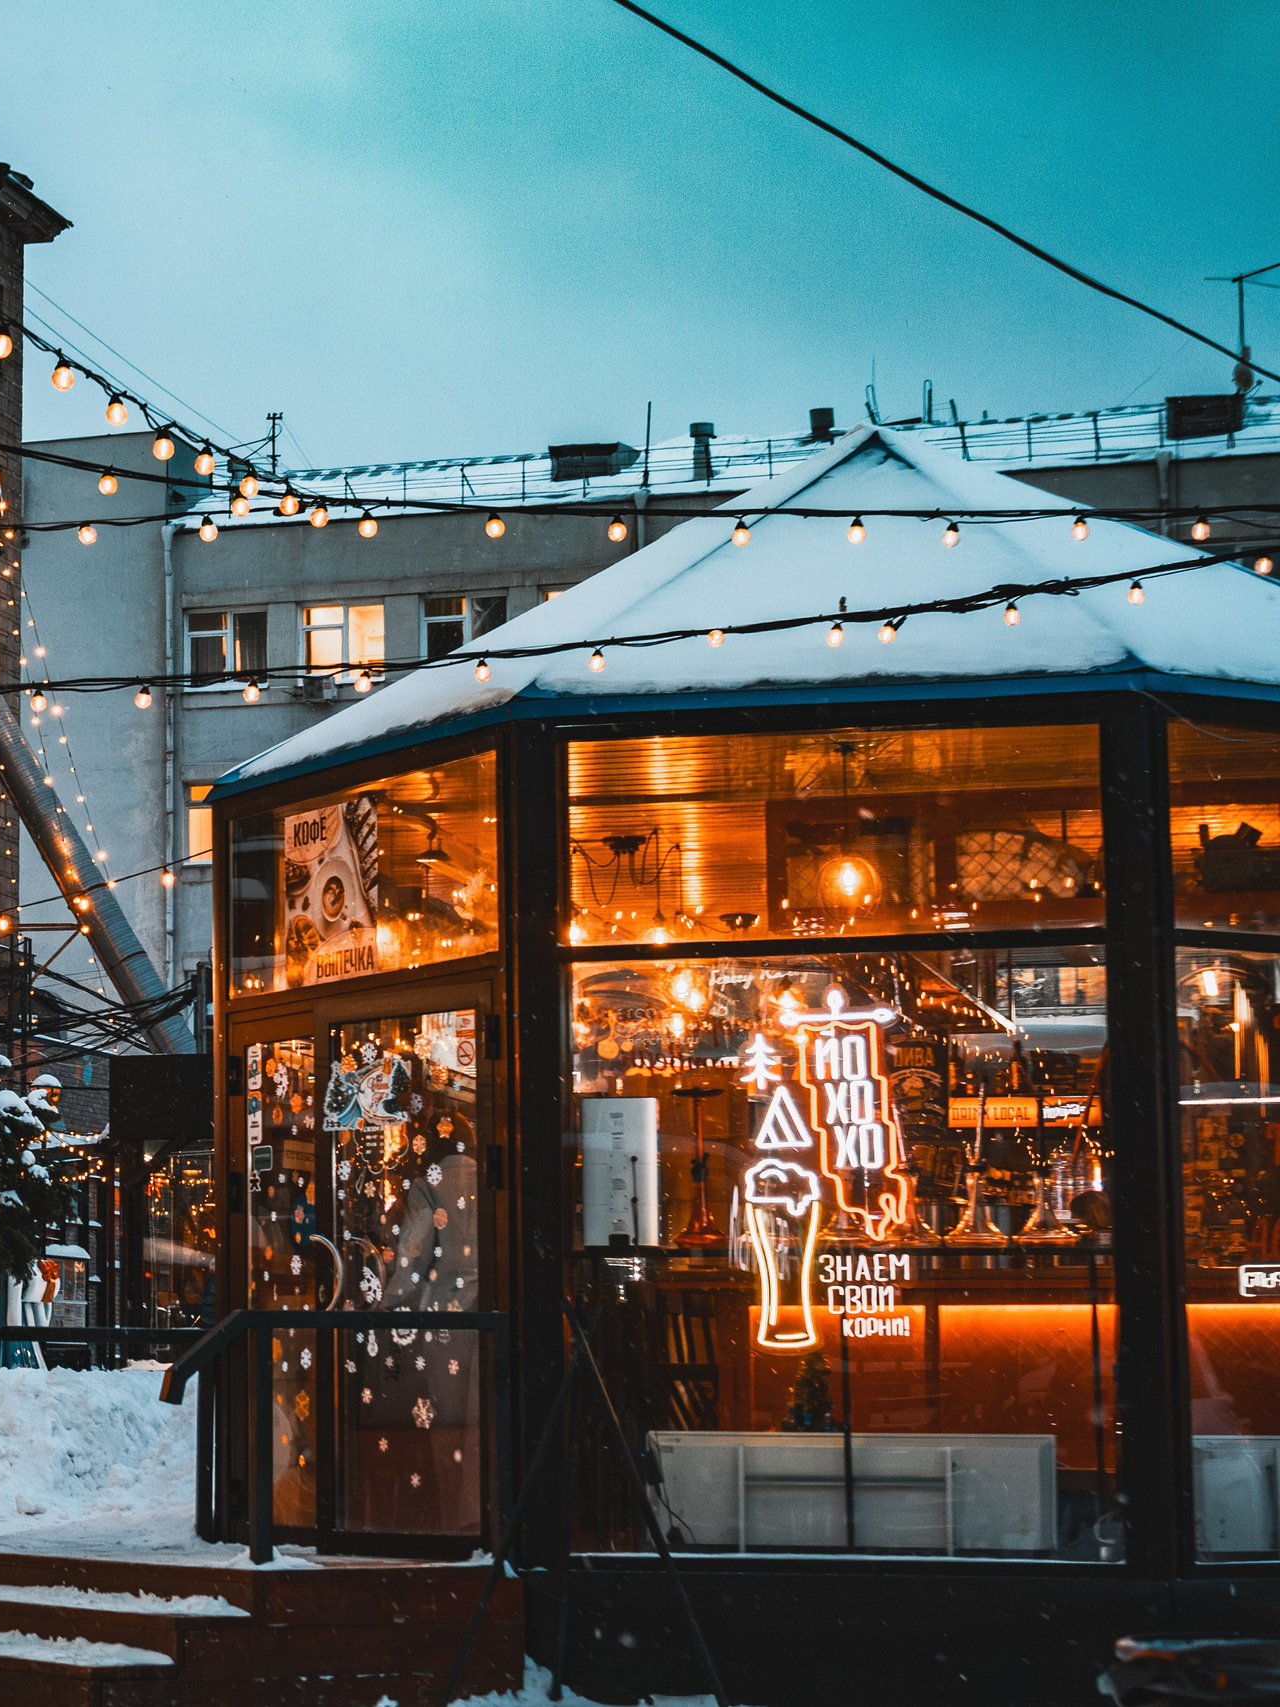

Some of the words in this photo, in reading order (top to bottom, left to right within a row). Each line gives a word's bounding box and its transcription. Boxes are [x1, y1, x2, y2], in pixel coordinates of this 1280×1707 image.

[293, 817, 327, 847] КОФЕ
[316, 945, 375, 979] ВЫПЕЧКА
[824, 1080, 875, 1125] ХО
[993, 1107, 1031, 1121] LOCAL
[833, 1123, 884, 1169] ХО
[818, 1253, 910, 1283] ЗНАЕМ
[827, 1284, 895, 1314] СВОИ
